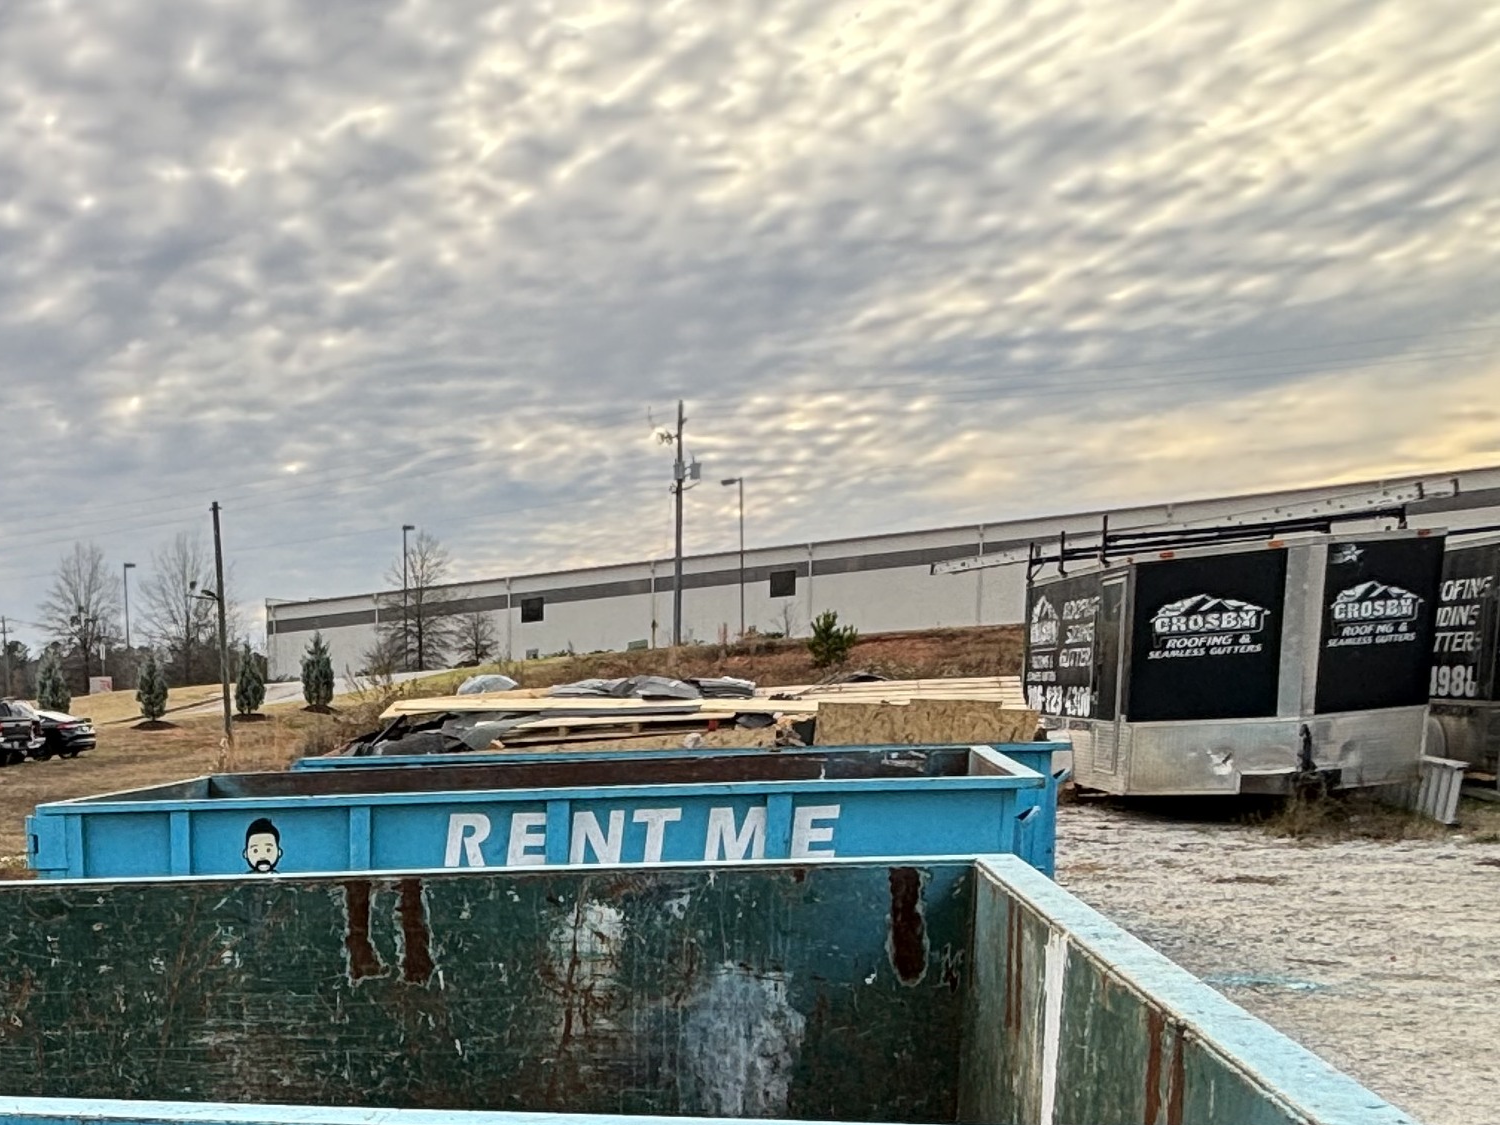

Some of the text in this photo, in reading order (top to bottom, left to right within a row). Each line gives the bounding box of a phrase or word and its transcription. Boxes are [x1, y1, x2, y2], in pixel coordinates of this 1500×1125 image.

[1334, 599, 1413, 620] CROSBY
[1155, 611, 1256, 633] CROSBY
[1147, 643, 1263, 660] SEAMLESS GUTTERS
[1165, 634, 1252, 649] ROOFING &
[444, 804, 841, 867] RENT ME
